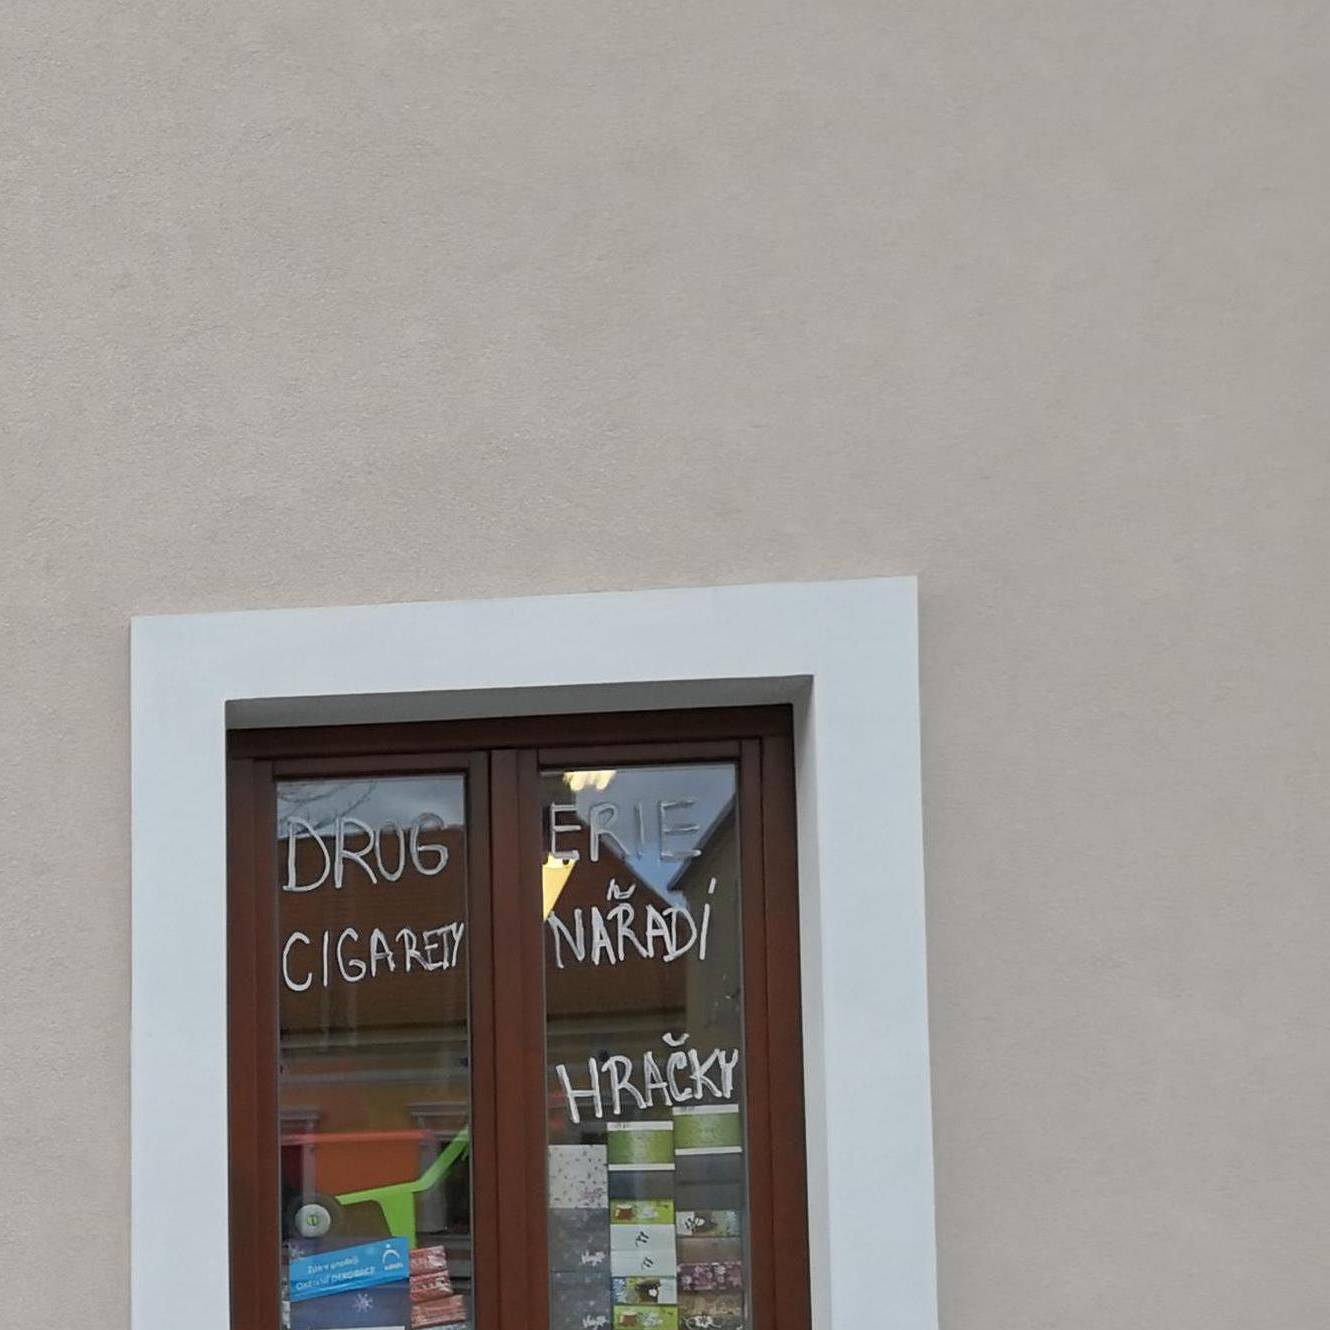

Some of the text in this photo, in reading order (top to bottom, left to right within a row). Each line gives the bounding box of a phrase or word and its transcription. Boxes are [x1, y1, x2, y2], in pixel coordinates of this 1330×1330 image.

[551, 800, 702, 862] ERIE
[282, 922, 464, 992] CIGARETY
[556, 1032, 739, 1124] HRAČKY
